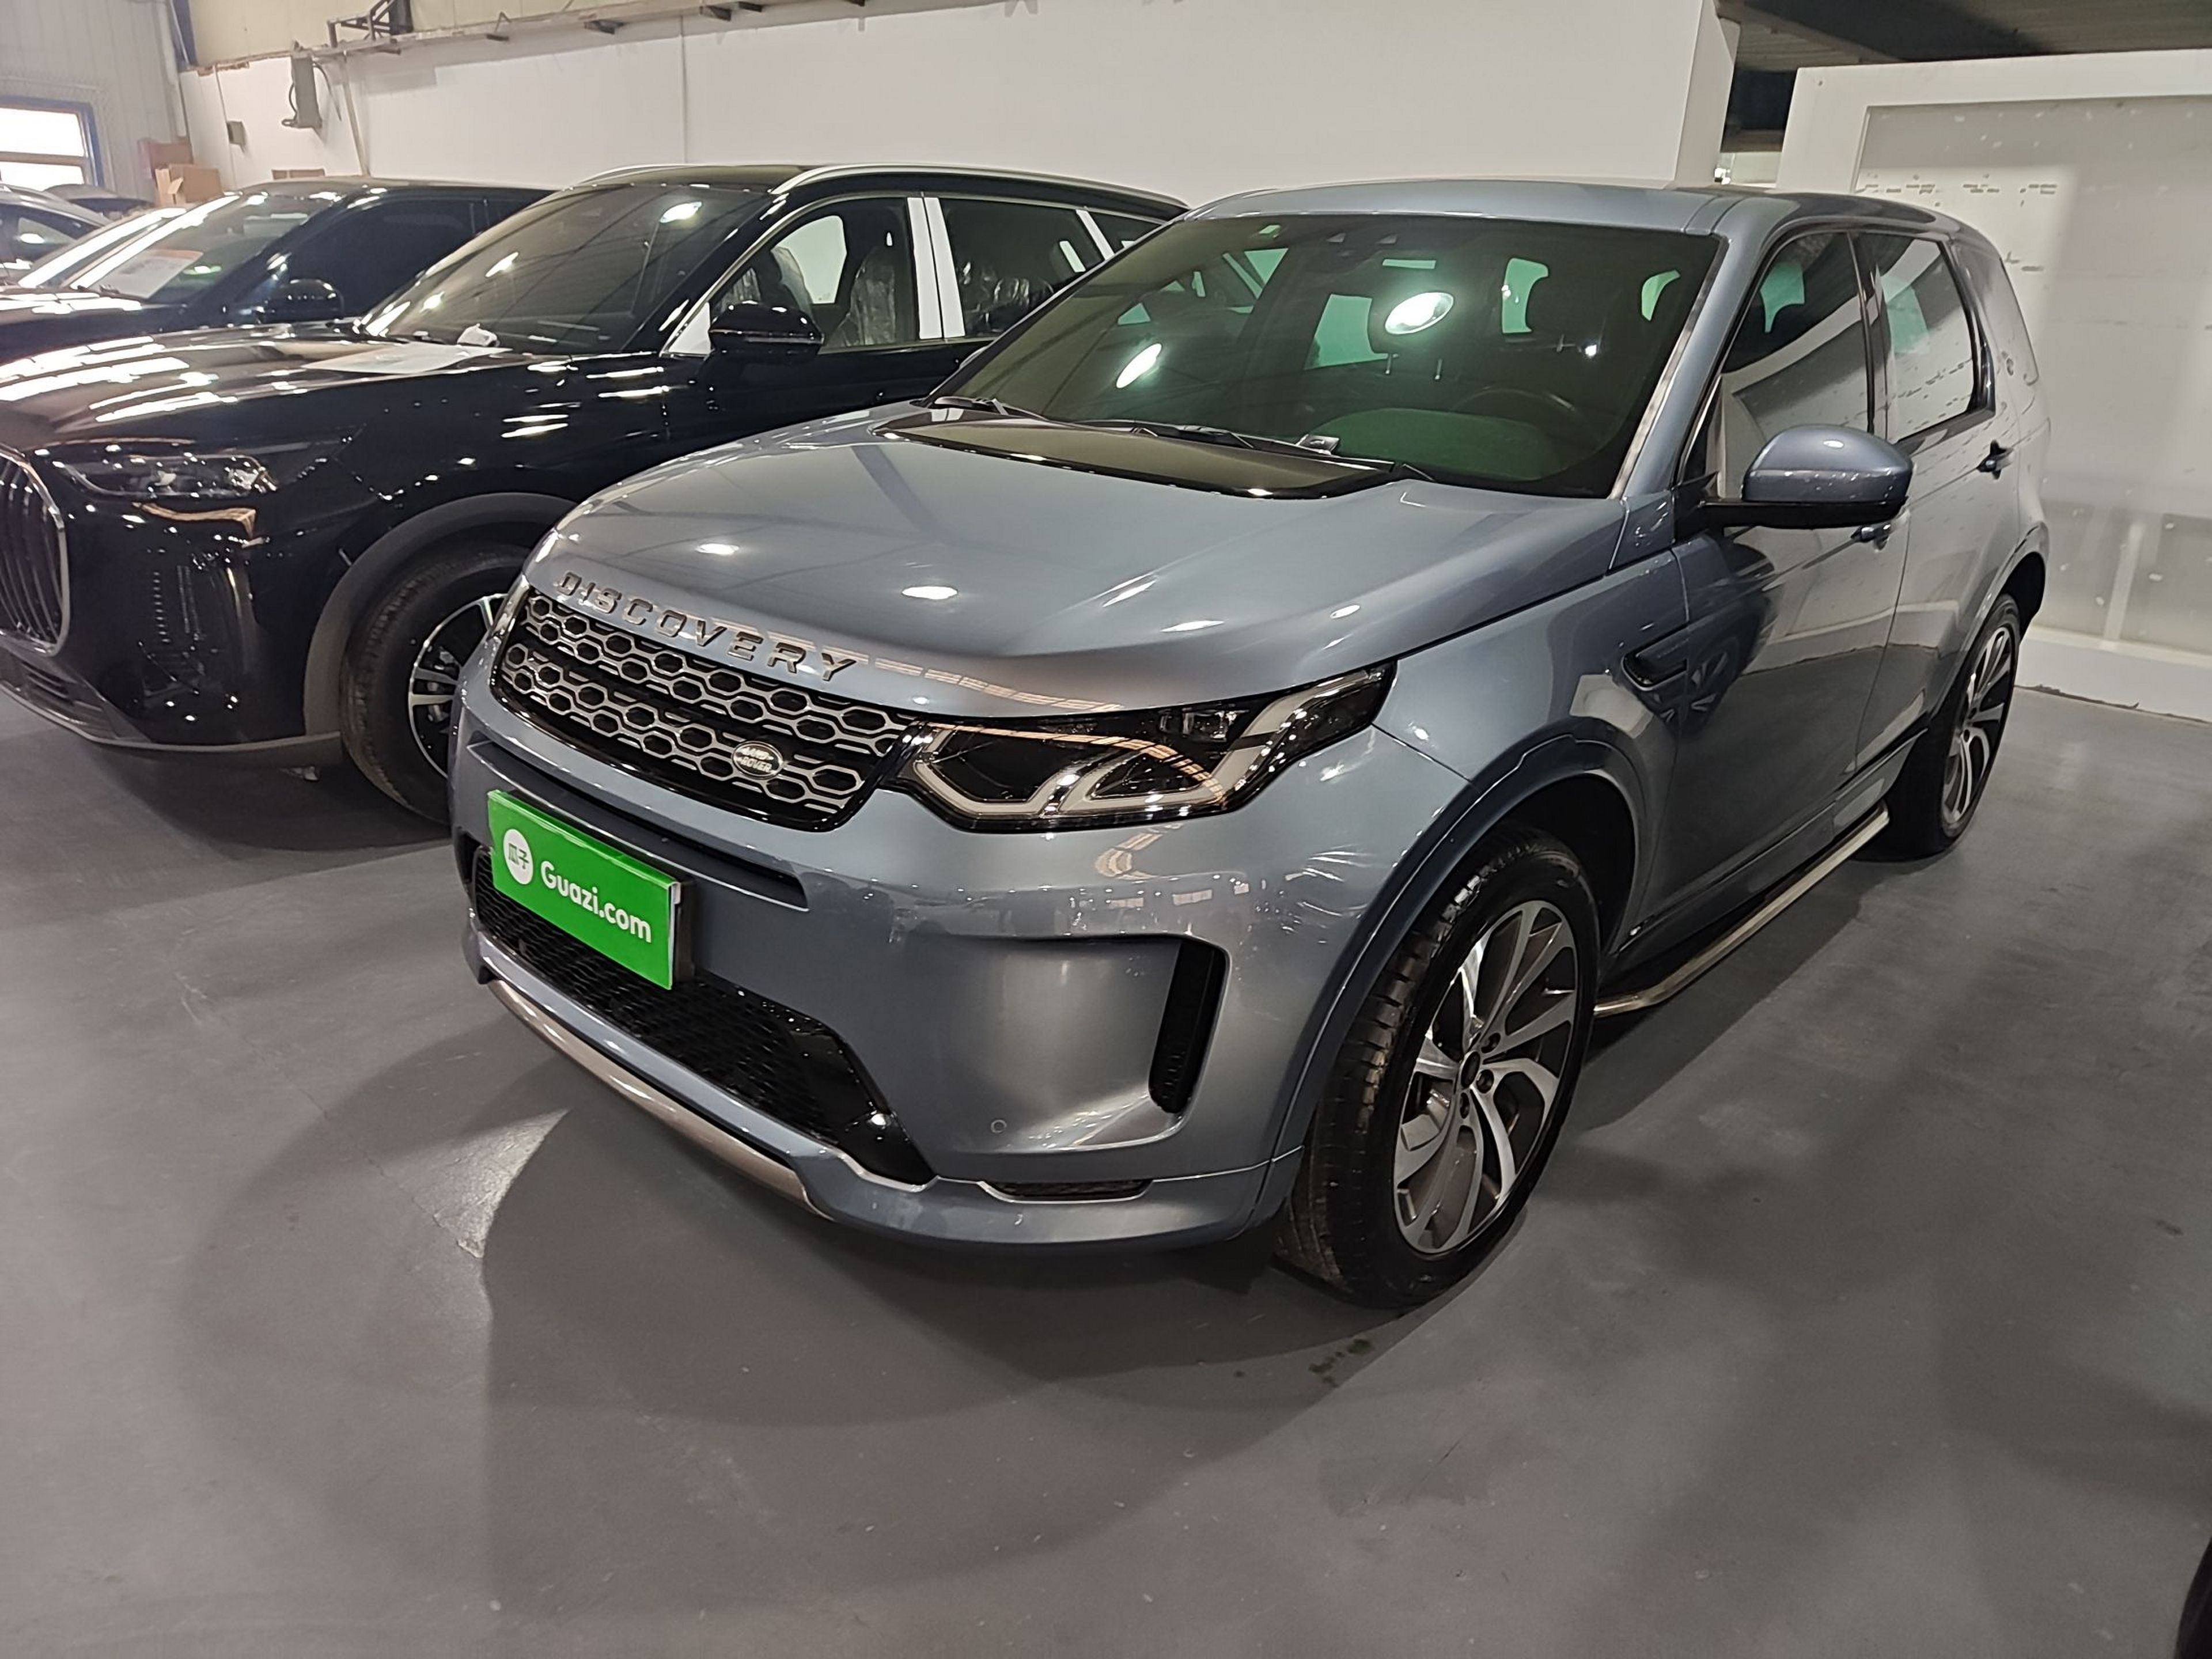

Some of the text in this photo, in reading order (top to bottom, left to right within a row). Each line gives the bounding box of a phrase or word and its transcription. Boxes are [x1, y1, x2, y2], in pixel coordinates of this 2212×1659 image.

[555, 571, 857, 681] DISCOVERY
[740, 756, 772, 773] ROVER
[540, 861, 652, 943] Guazi.com
